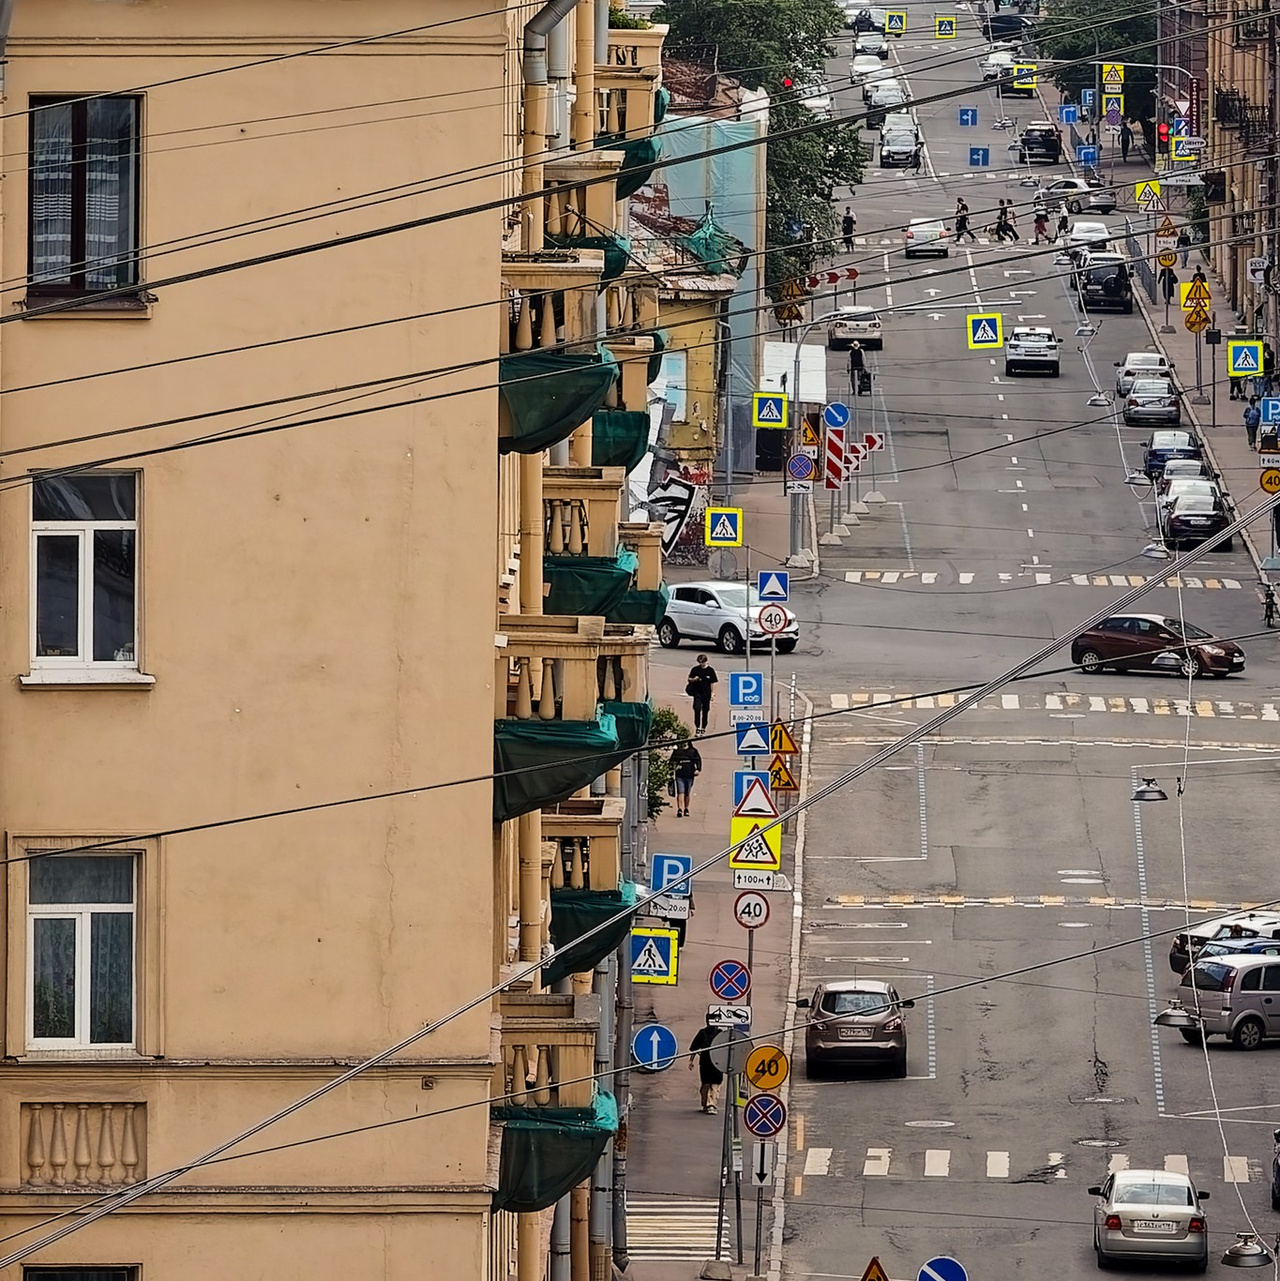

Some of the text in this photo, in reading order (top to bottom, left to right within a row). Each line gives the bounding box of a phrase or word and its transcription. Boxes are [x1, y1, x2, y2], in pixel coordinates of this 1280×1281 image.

[1266, 475, 1280, 486] 40
[764, 613, 781, 625] 40
[738, 676, 757, 702] P
[743, 874, 765, 884] 100м
[741, 902, 763, 917] 40
[755, 1058, 780, 1076] 40
